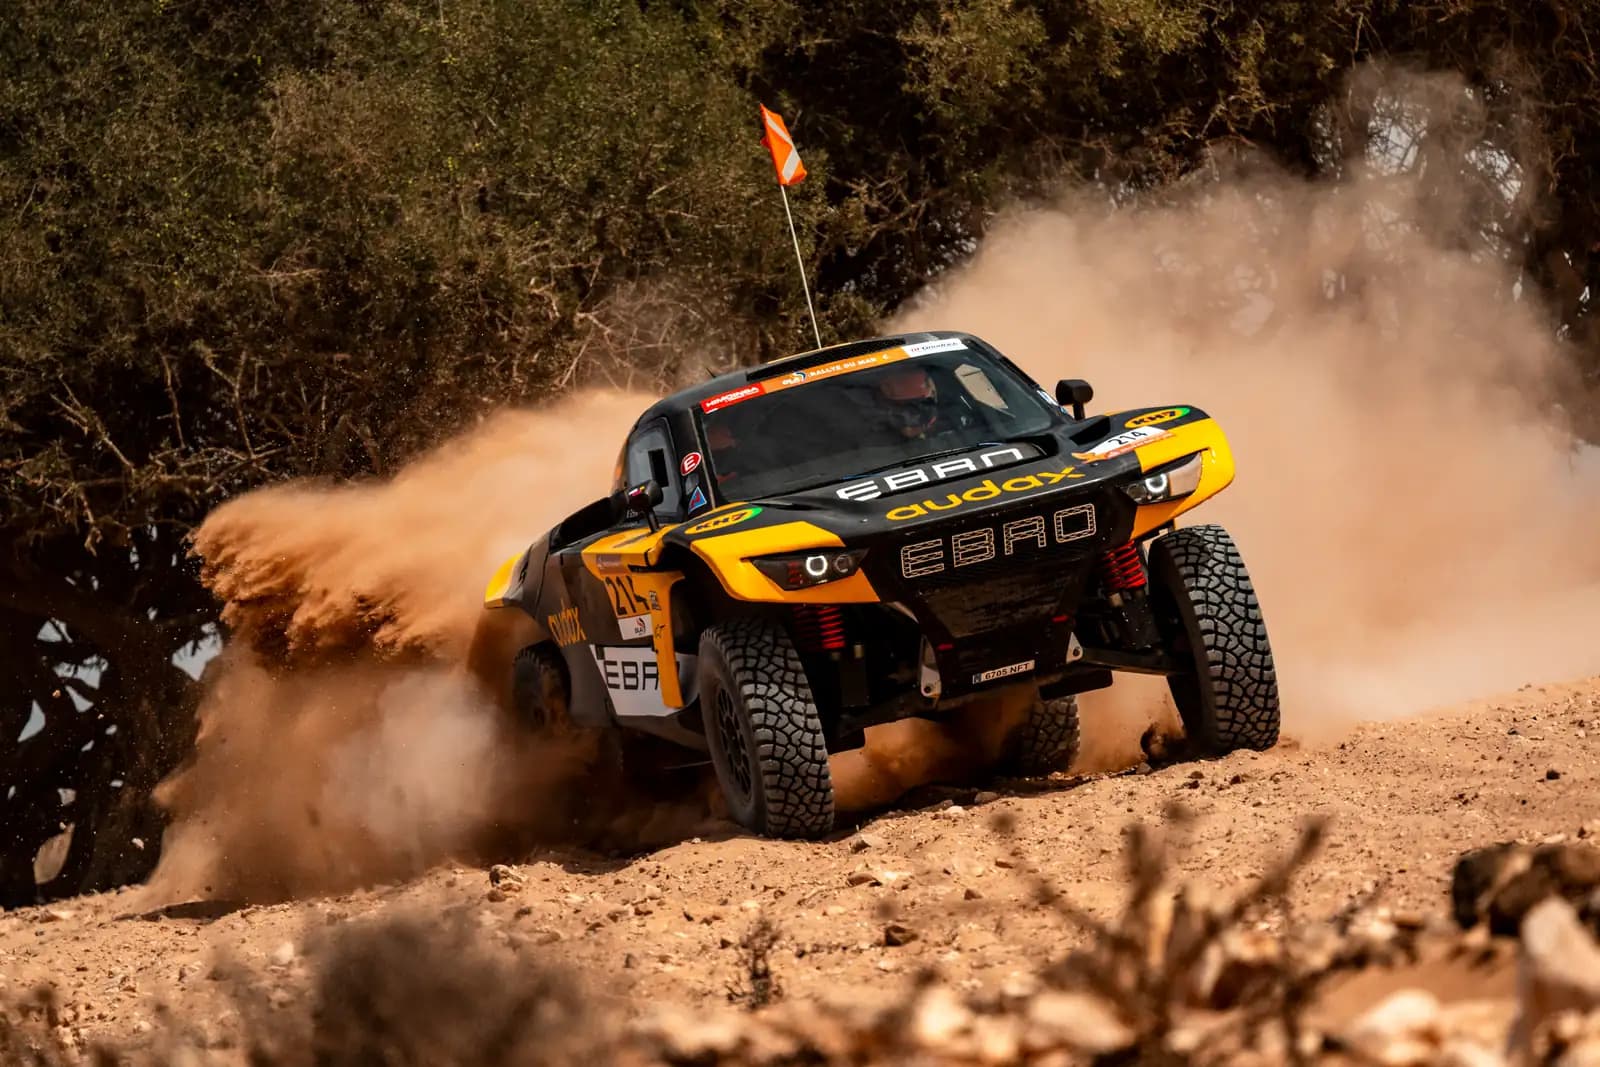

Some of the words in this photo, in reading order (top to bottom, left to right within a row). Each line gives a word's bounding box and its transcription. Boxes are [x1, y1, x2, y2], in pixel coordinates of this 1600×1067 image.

[810, 363, 843, 377] RALLYE
[843, 361, 856, 369] DU
[1131, 410, 1177, 426] KH7
[1107, 430, 1148, 446] 214
[886, 466, 1085, 521] audax
[695, 510, 749, 532] KH7
[900, 503, 1097, 579] EBRO
[604, 575, 650, 616] 214
[604, 660, 670, 691] EBR
[985, 668, 1008, 680] 6705
[1009, 662, 1031, 673] NFT
